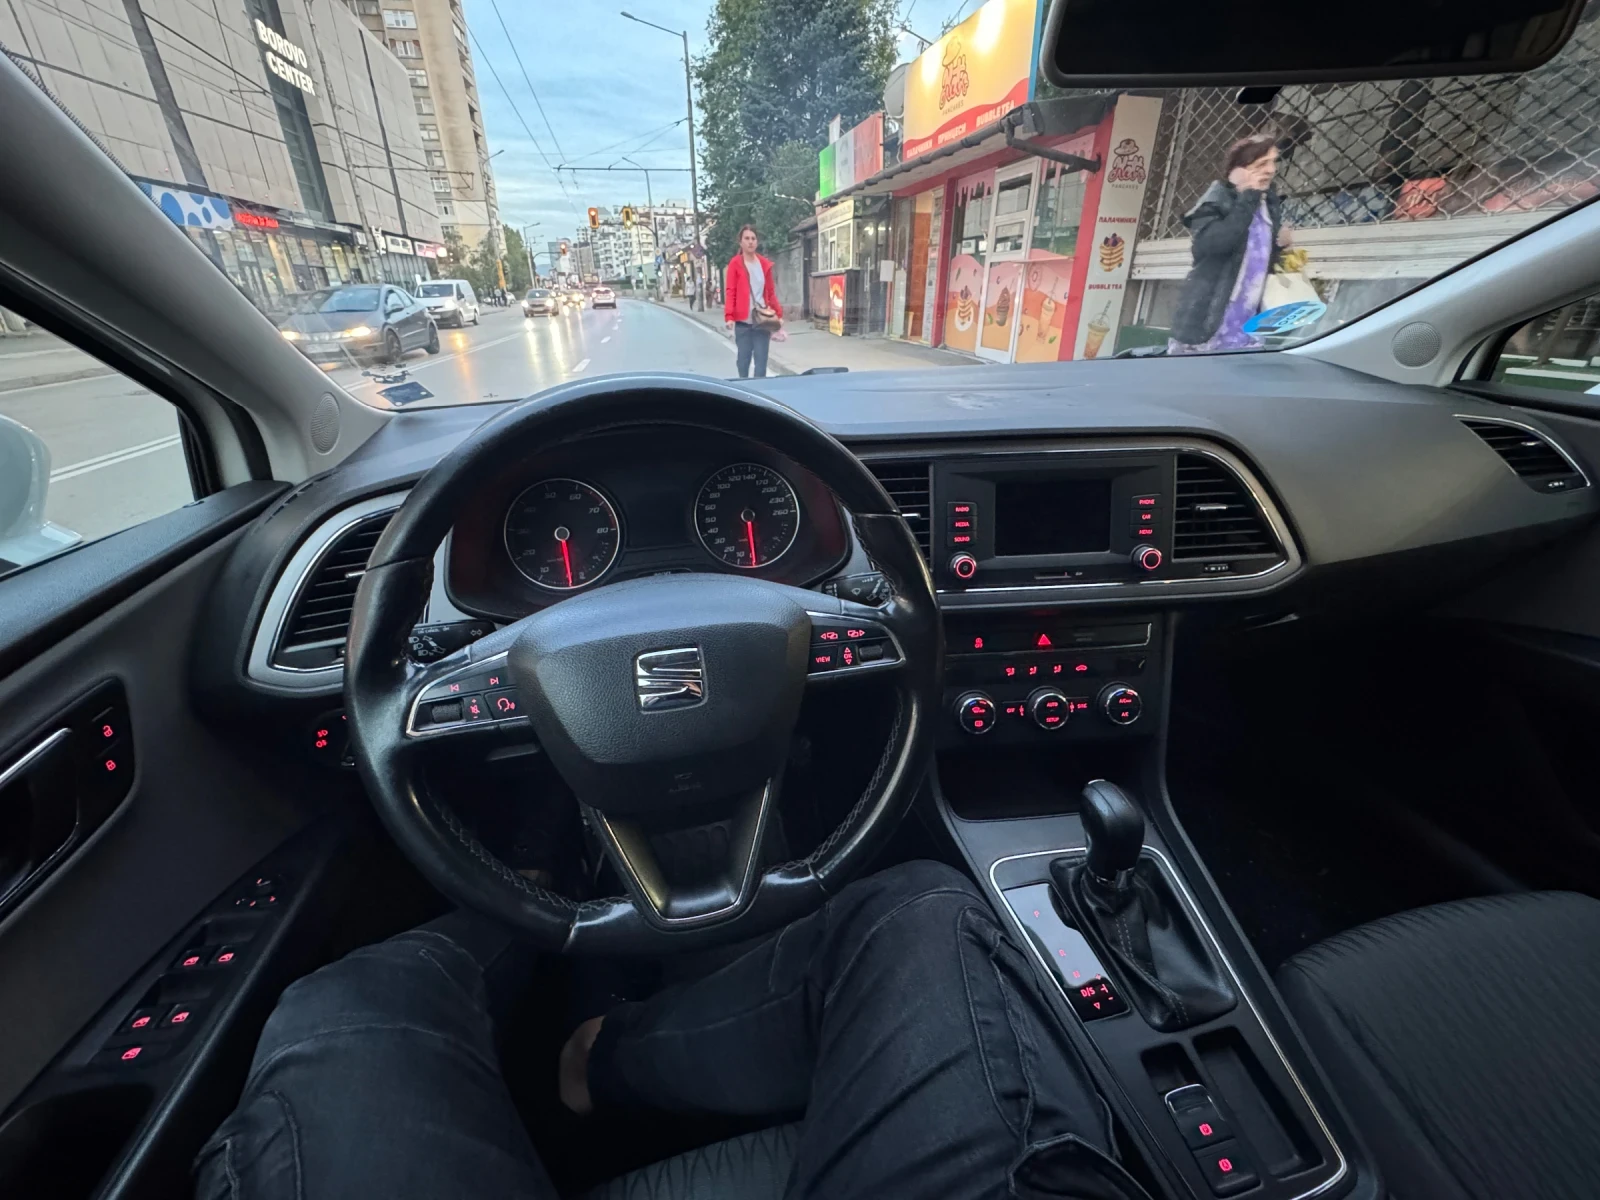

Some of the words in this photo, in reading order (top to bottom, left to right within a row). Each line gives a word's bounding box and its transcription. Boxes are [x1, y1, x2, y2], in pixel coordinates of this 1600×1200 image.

[254, 18, 308, 69] BOROVO
[265, 51, 316, 96] CENTER
[1098, 216, 1137, 224] ПАЛАЧИНКИ
[723, 545, 736, 553] 20
[815, 655, 831, 663] VIEW
[1080, 987, 1096, 997] D/S
